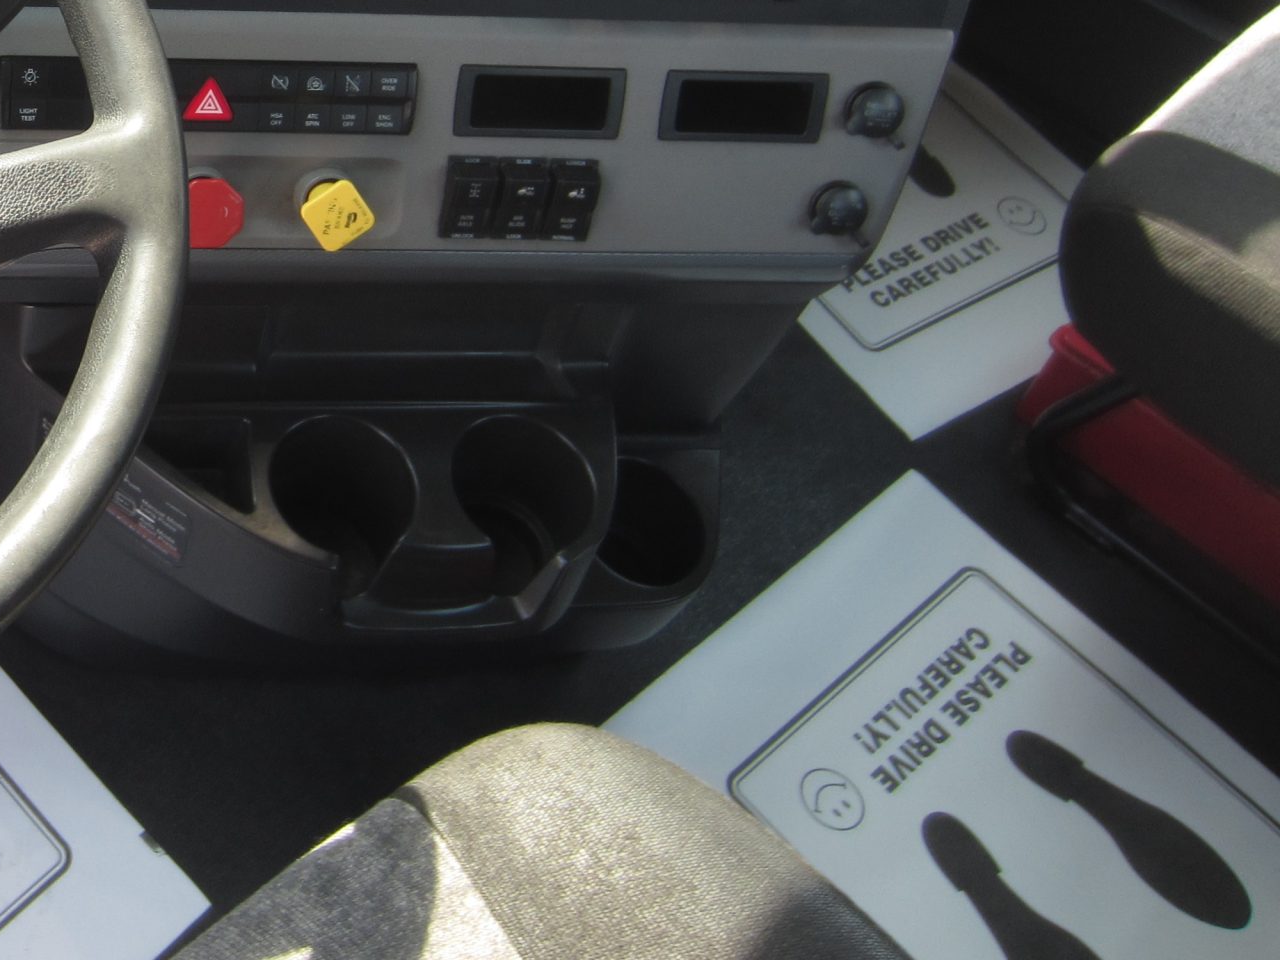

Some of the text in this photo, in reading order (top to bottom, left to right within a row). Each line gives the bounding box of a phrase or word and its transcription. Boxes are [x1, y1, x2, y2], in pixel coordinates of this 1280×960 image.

[841, 212, 990, 293] PLEASE DRIVE
[870, 237, 1001, 308] CAREFULLY!
[853, 627, 992, 755] CAREFULLY!
[871, 640, 1033, 794] PLEASE DRIVE
